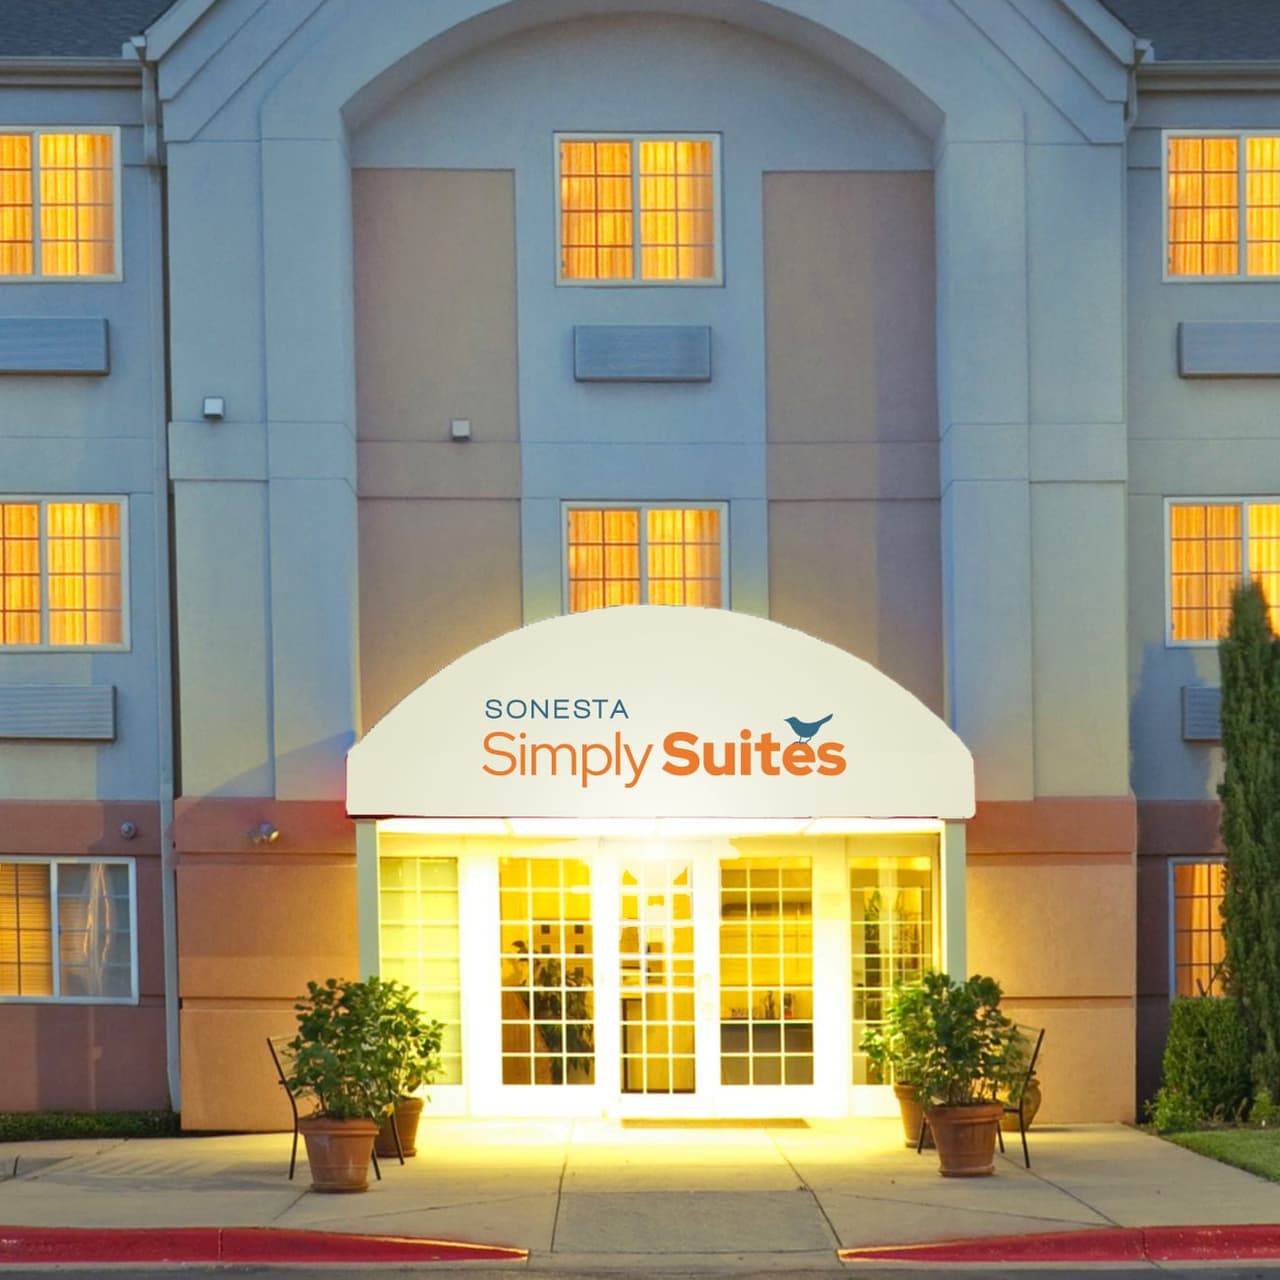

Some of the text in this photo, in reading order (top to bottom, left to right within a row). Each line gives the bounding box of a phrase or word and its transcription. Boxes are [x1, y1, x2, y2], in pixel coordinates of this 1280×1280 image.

[485, 698, 629, 720] SONESTA
[482, 728, 847, 788] Simply Suites
